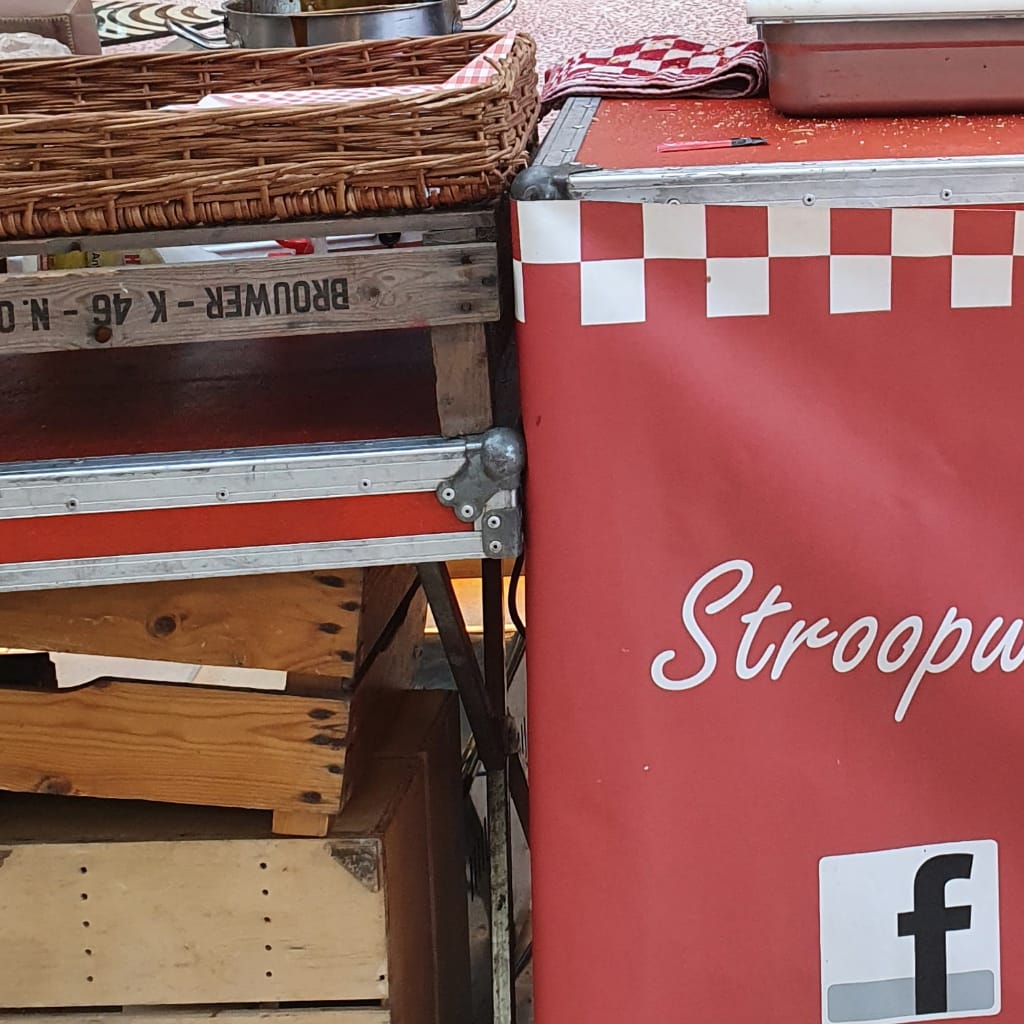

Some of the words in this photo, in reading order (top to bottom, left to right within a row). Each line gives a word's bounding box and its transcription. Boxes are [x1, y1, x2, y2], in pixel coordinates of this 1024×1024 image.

[92, 293, 133, 326] 46
[147, 290, 168, 323] K
[204, 278, 350, 319] BROUWER
